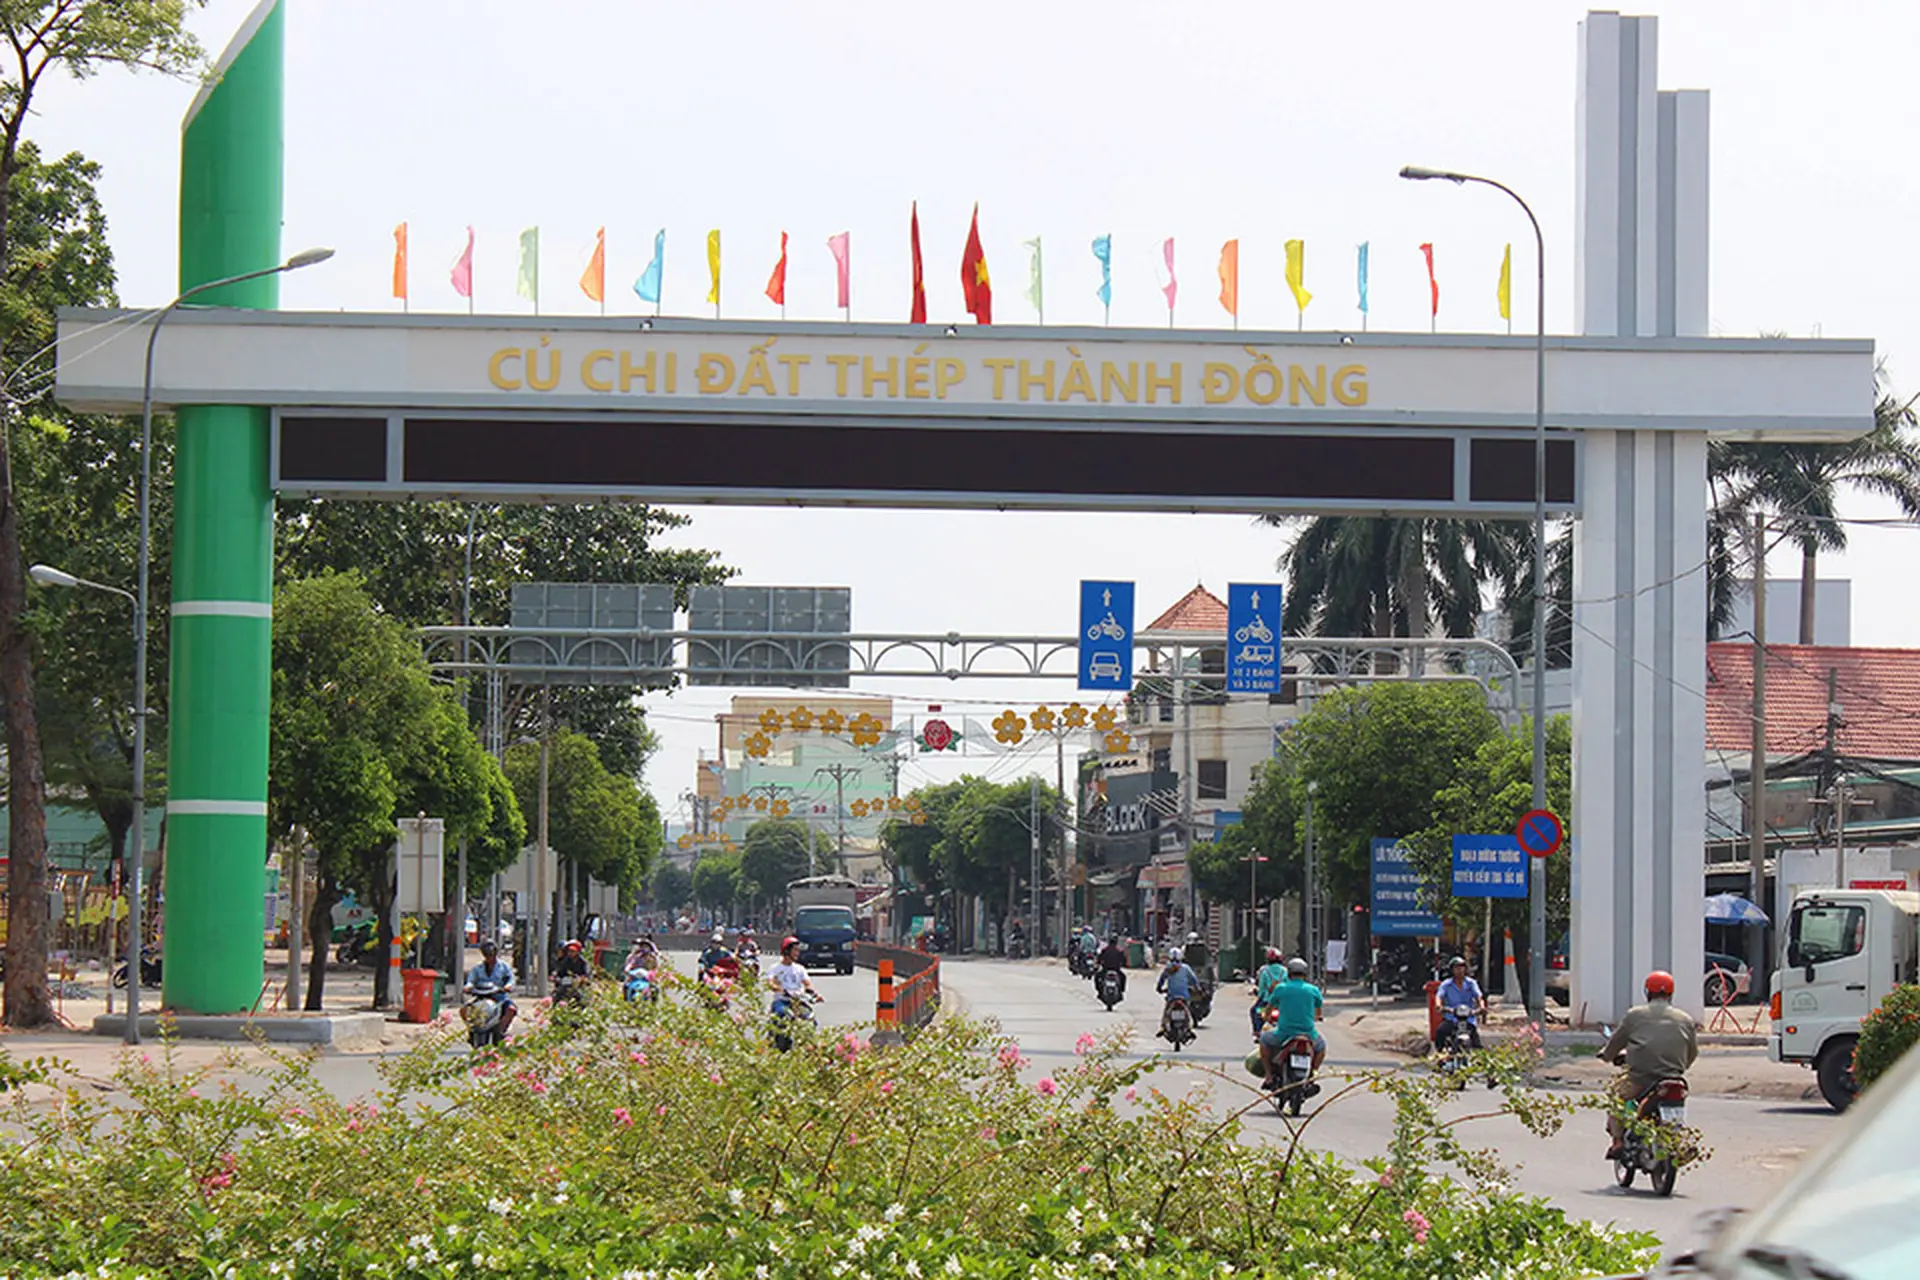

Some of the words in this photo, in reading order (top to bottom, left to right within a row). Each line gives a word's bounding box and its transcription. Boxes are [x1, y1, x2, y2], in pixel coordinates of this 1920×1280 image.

[488, 336, 561, 391] CỦ
[581, 349, 677, 393] CHI
[695, 336, 811, 396] ĐẤT
[827, 343, 965, 399] THÉP
[983, 346, 1182, 404] THÀNH
[1200, 346, 1368, 406] ĐỒNG
